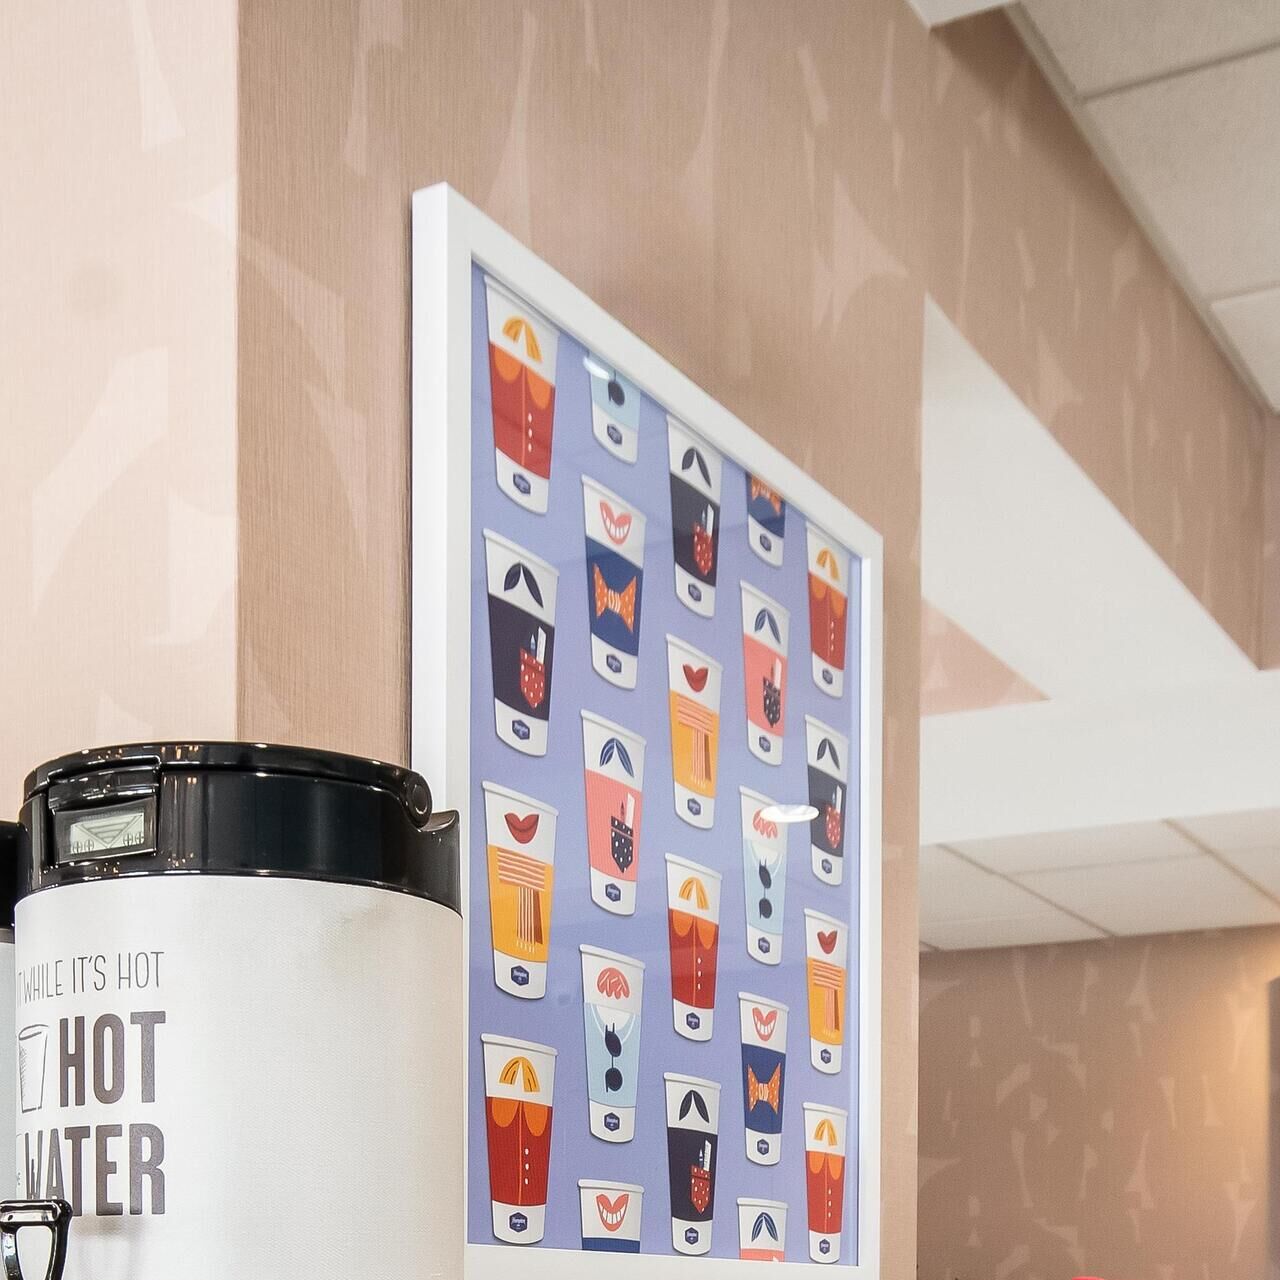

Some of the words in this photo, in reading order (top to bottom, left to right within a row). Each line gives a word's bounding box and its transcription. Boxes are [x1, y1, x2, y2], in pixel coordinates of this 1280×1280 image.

[23, 959, 64, 1004] WHILE
[72, 955, 107, 994] IT'S
[118, 951, 165, 990] HOT
[59, 1010, 167, 1108] HOT
[25, 1123, 166, 1217] WATER
